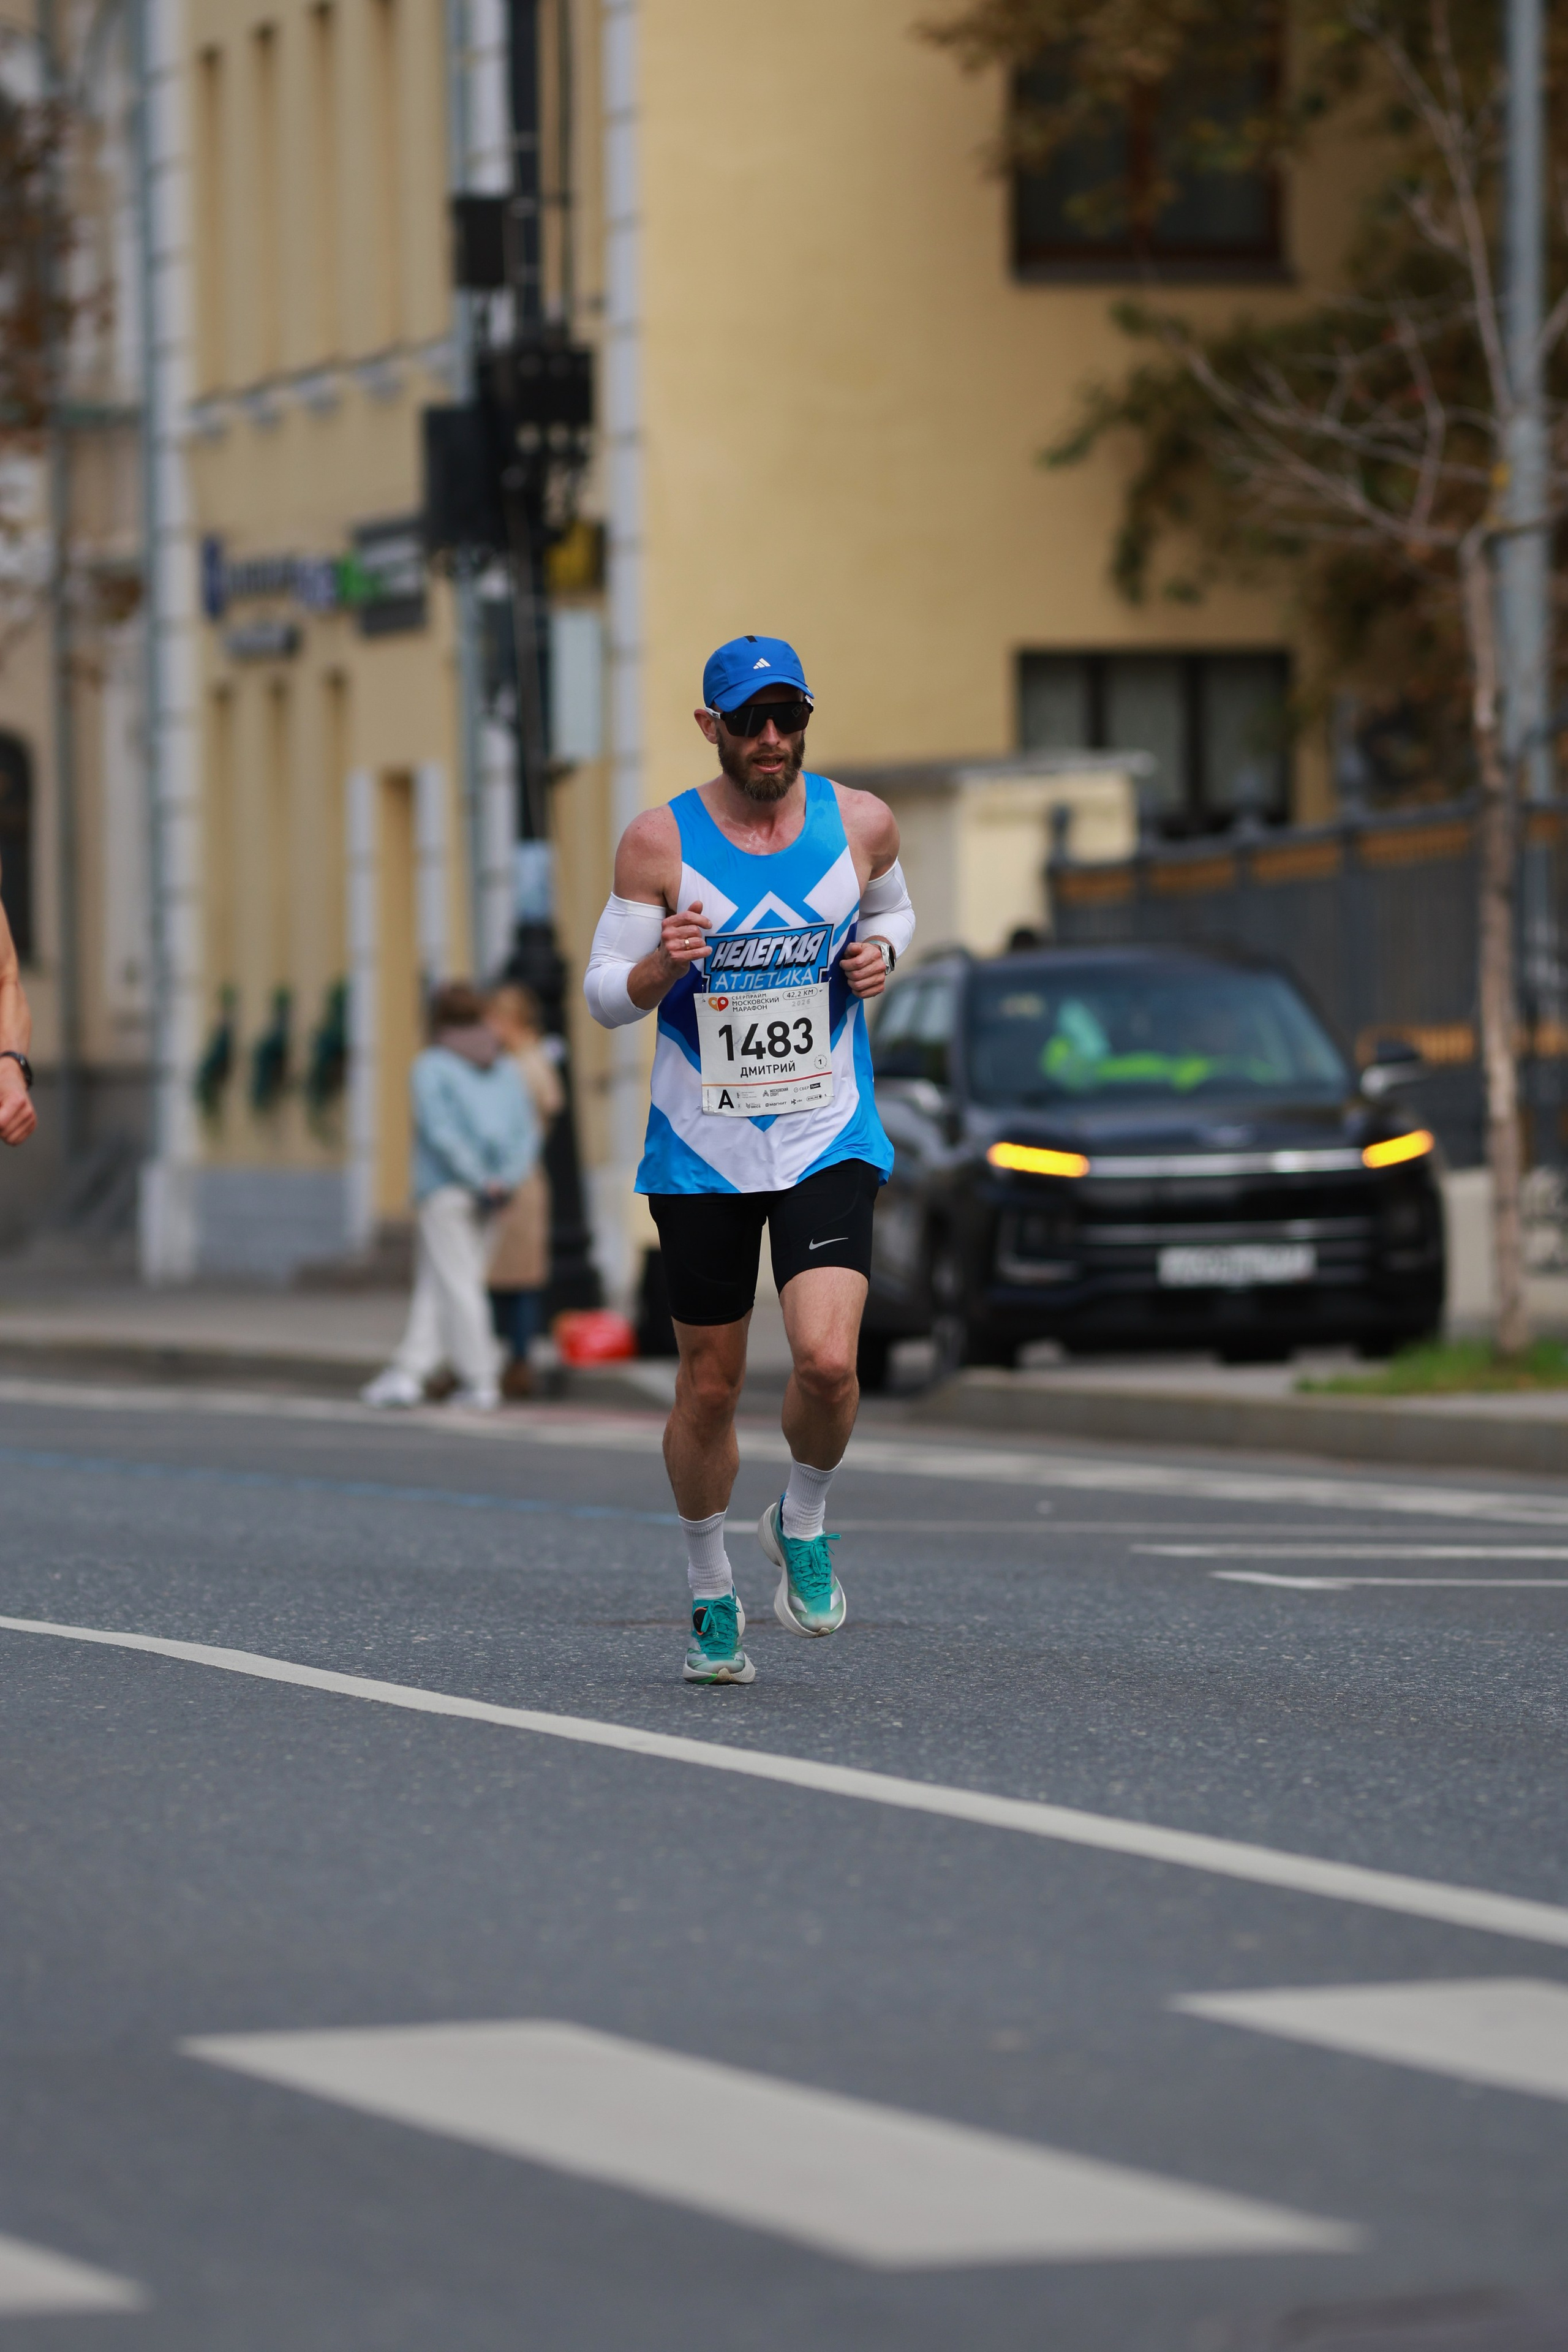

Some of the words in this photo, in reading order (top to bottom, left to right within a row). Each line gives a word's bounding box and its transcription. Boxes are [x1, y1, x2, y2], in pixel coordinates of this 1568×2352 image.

[710, 930, 827, 971] НЕЛЕГКАЯ
[715, 968, 814, 990] АТЛЕТИКА
[732, 997, 779, 1006] МОСКОВСКИЙ
[718, 1017, 813, 1061] 1483
[741, 1060, 796, 1078] ДМИТРИЙ
[718, 1089, 734, 1109] A
